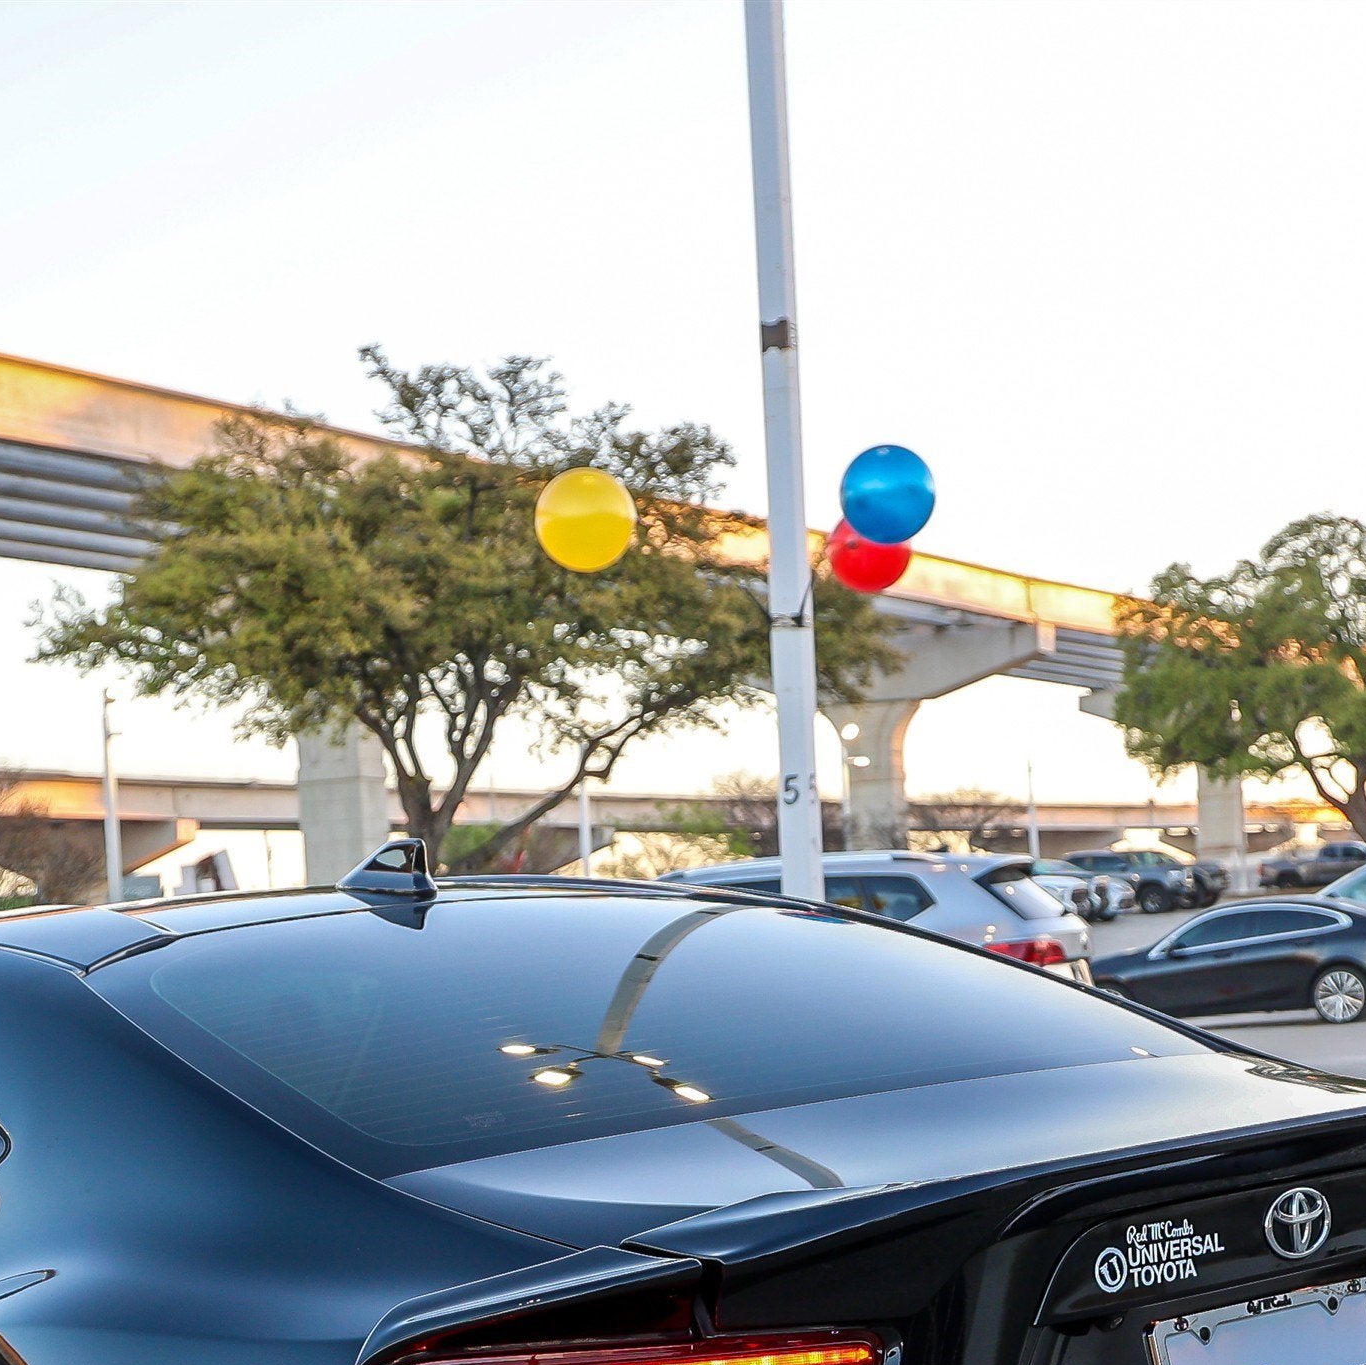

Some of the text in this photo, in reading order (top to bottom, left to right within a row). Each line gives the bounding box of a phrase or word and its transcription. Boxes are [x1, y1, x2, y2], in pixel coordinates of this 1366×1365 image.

[784, 774, 798, 804] 5
[1126, 1219, 1194, 1249] Red McCombs
[1128, 1233, 1225, 1267] UNIVERSAL
[1130, 1259, 1197, 1288] TOYOTA
